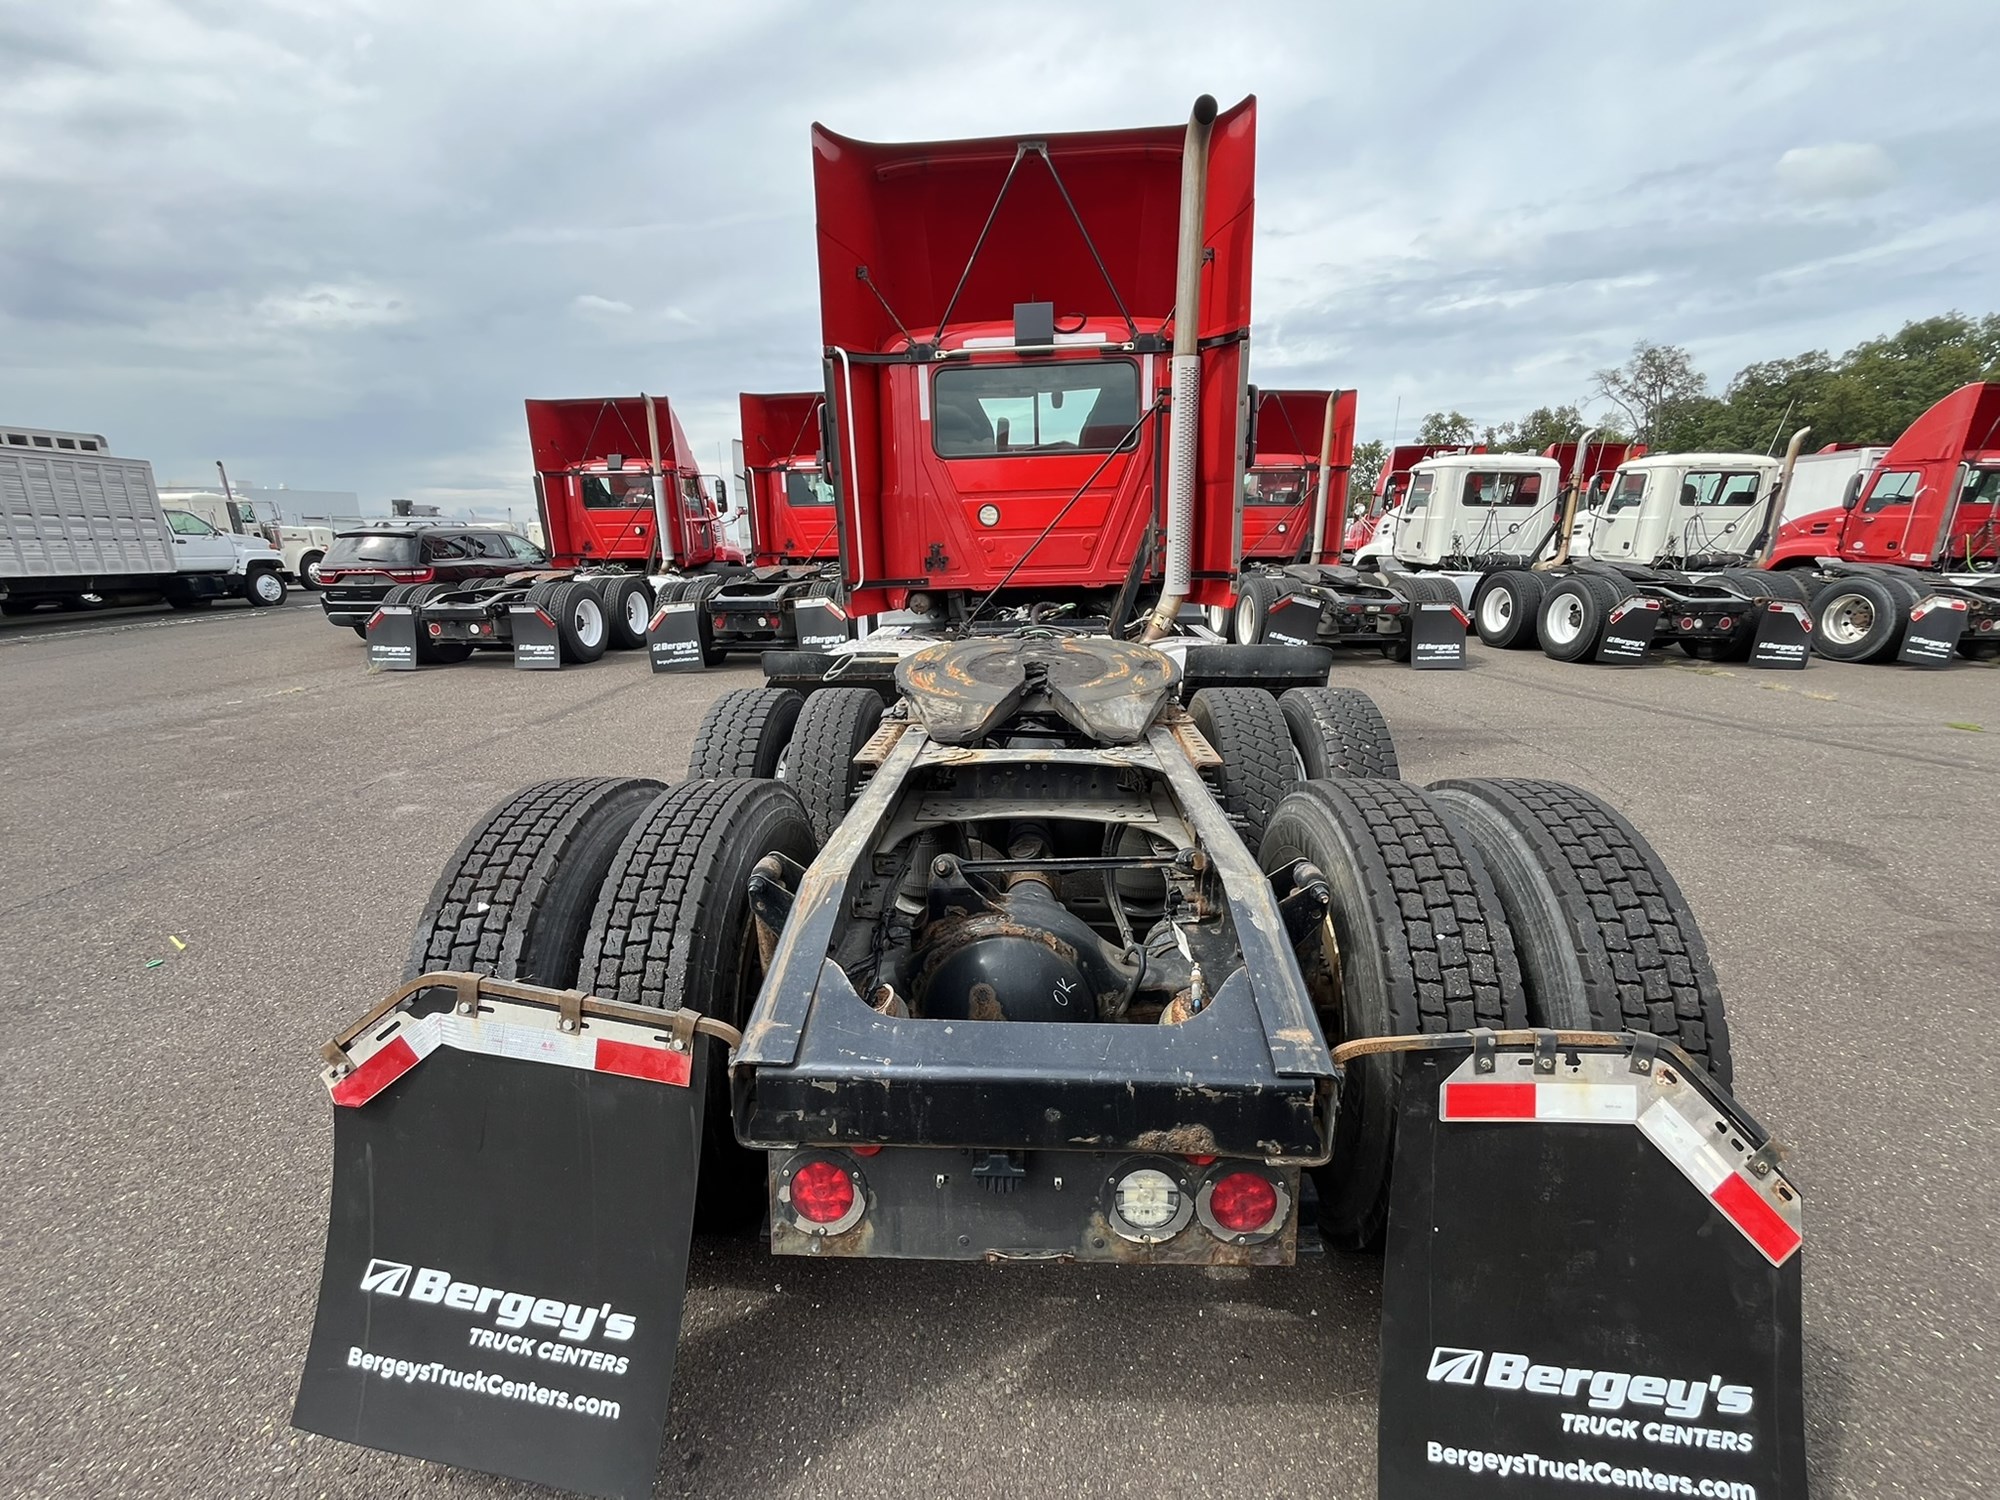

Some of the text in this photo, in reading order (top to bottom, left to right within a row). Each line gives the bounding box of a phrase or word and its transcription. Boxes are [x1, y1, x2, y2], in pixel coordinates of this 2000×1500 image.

[661, 640, 698, 651] Bergey's
[1053, 977, 1077, 1006] OK
[409, 1267, 637, 1341] Bergey's
[469, 1327, 630, 1375] TRUCK CENTERS
[347, 1346, 621, 1419] BergeysTruckCenters.com
[1483, 1351, 1754, 1418] Bergey's
[1560, 1412, 1754, 1452] TRUCK CENTERS
[1427, 1441, 1756, 1500] BergeysTruckCenters.com
